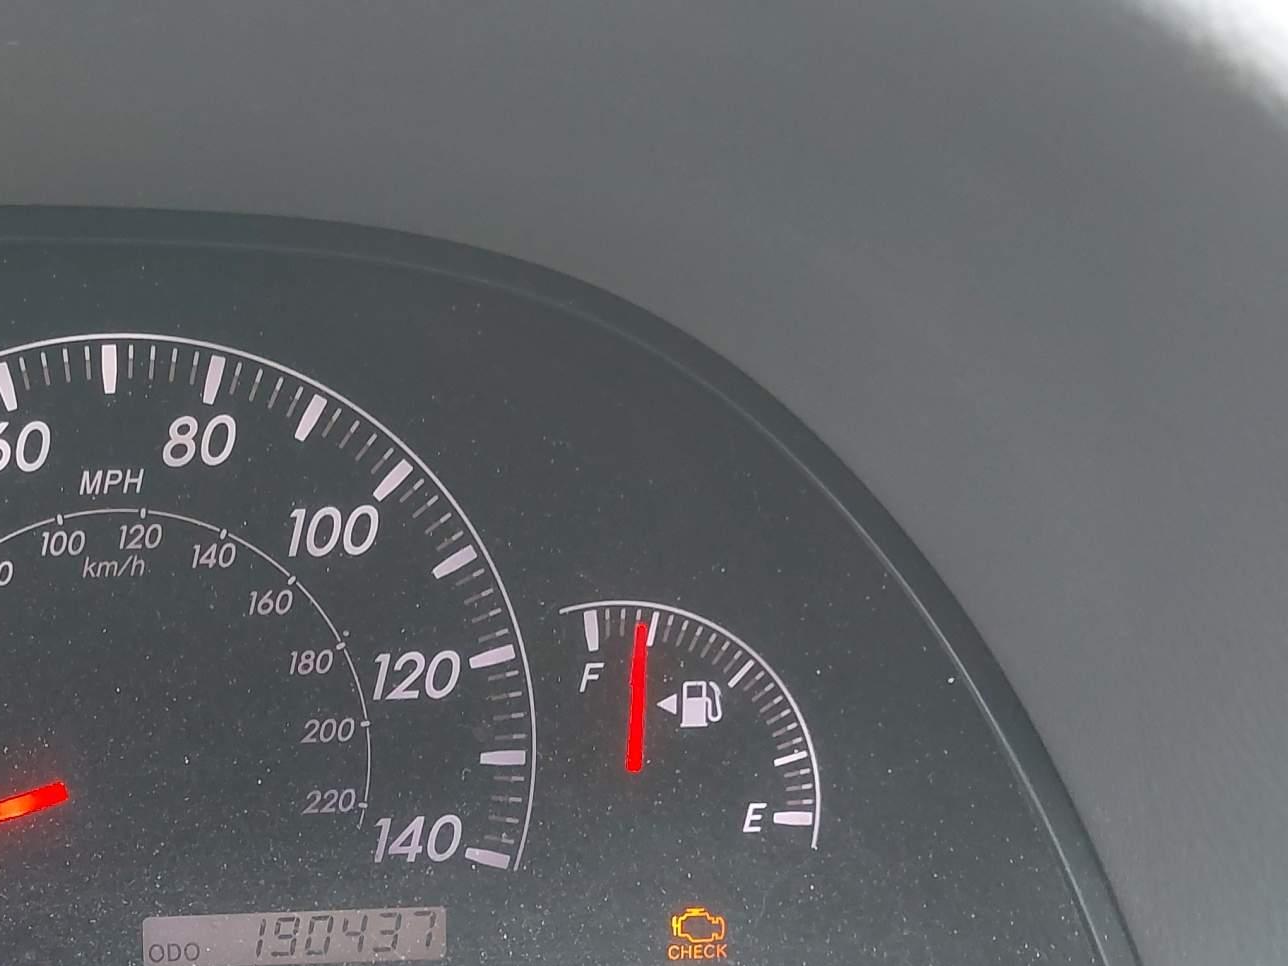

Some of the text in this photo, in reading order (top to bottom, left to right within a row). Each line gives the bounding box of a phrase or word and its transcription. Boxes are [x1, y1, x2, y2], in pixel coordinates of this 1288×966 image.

[162, 414, 236, 467] 80
[79, 468, 145, 496] MPH
[41, 530, 86, 556] 100
[119, 523, 162, 550] 120
[288, 504, 379, 557] 100
[82, 554, 145, 579] km/h
[192, 542, 236, 569] 140
[249, 589, 293, 616] 160
[289, 649, 334, 675] 180
[373, 649, 461, 701] 120
[579, 662, 605, 693] F
[300, 718, 355, 743] 200
[302, 788, 356, 814] 220
[742, 802, 767, 833] E
[374, 814, 462, 863] 140
[148, 911, 437, 963] ODO 190437
[667, 943, 727, 960] CHECK
